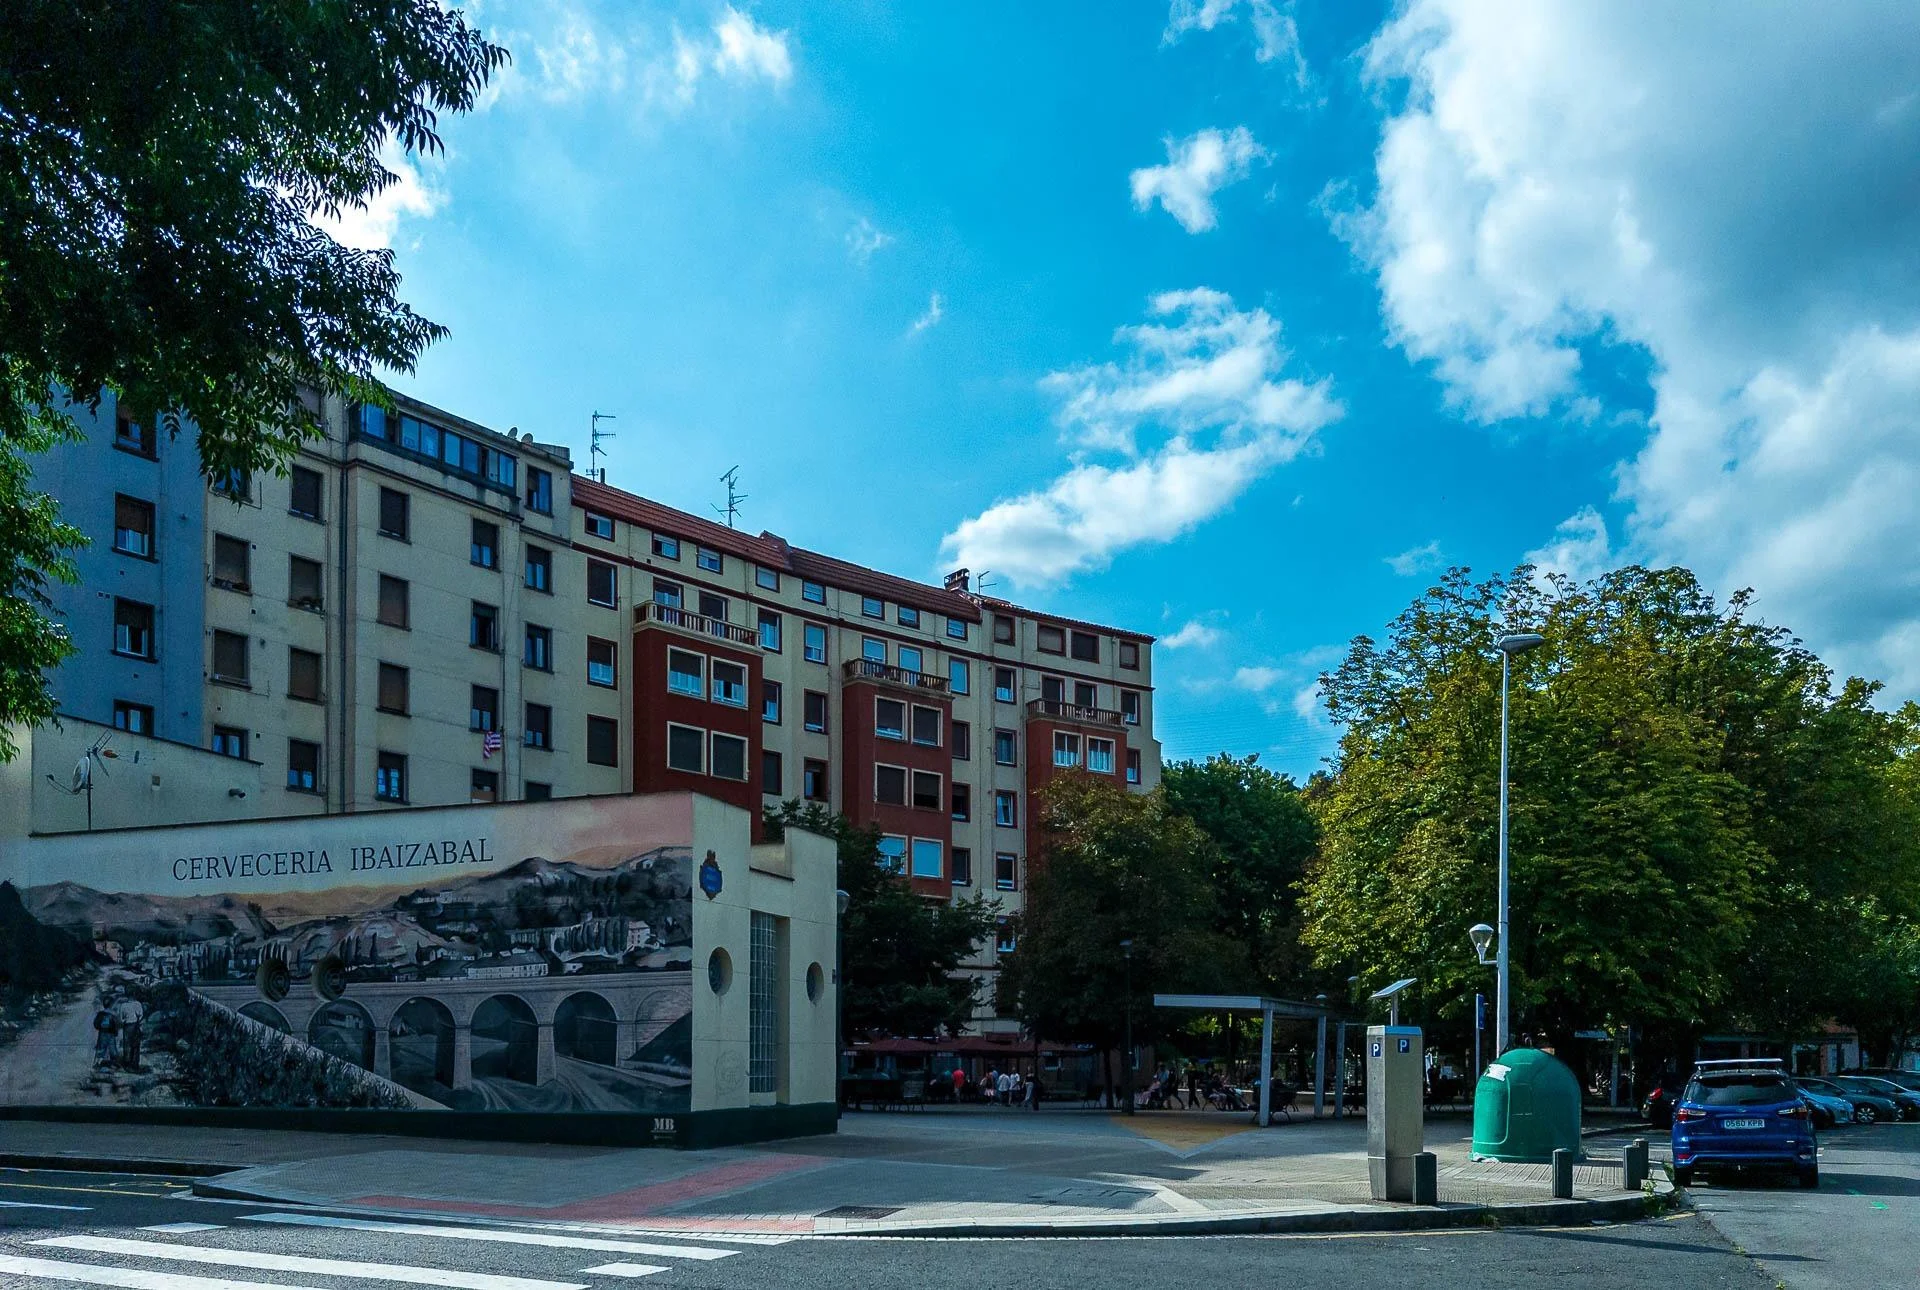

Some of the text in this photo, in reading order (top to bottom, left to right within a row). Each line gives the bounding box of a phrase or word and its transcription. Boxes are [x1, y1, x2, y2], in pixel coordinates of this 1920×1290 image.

[172, 838, 494, 881] CERVECERIA IBAIZABAL
[1373, 1043, 1379, 1056] P
[1400, 1039, 1407, 1052] P
[654, 1117, 675, 1130] MB
